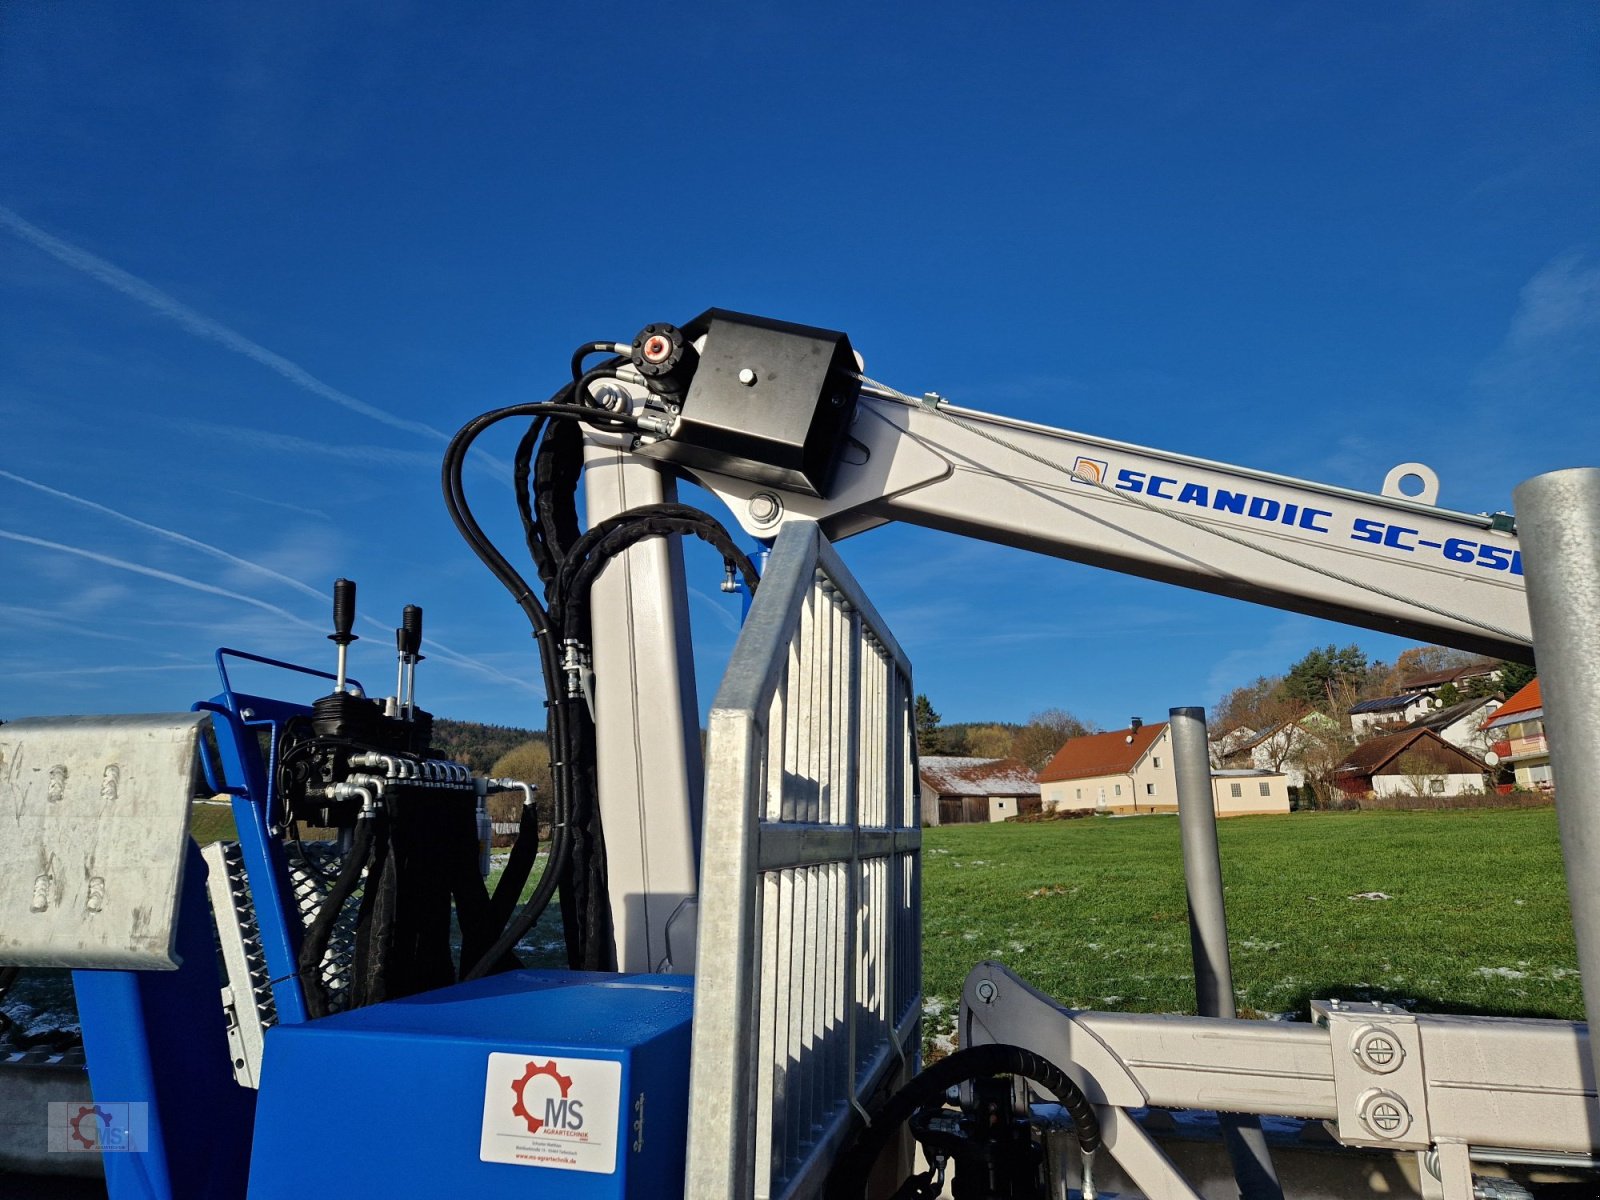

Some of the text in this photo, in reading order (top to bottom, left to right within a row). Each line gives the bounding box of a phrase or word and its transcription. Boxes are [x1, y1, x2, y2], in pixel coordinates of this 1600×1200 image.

[1116, 469, 1332, 533] SCANDIC
[545, 1098, 584, 1130] MS
[543, 1128, 589, 1137] AGRARTECHNIK
